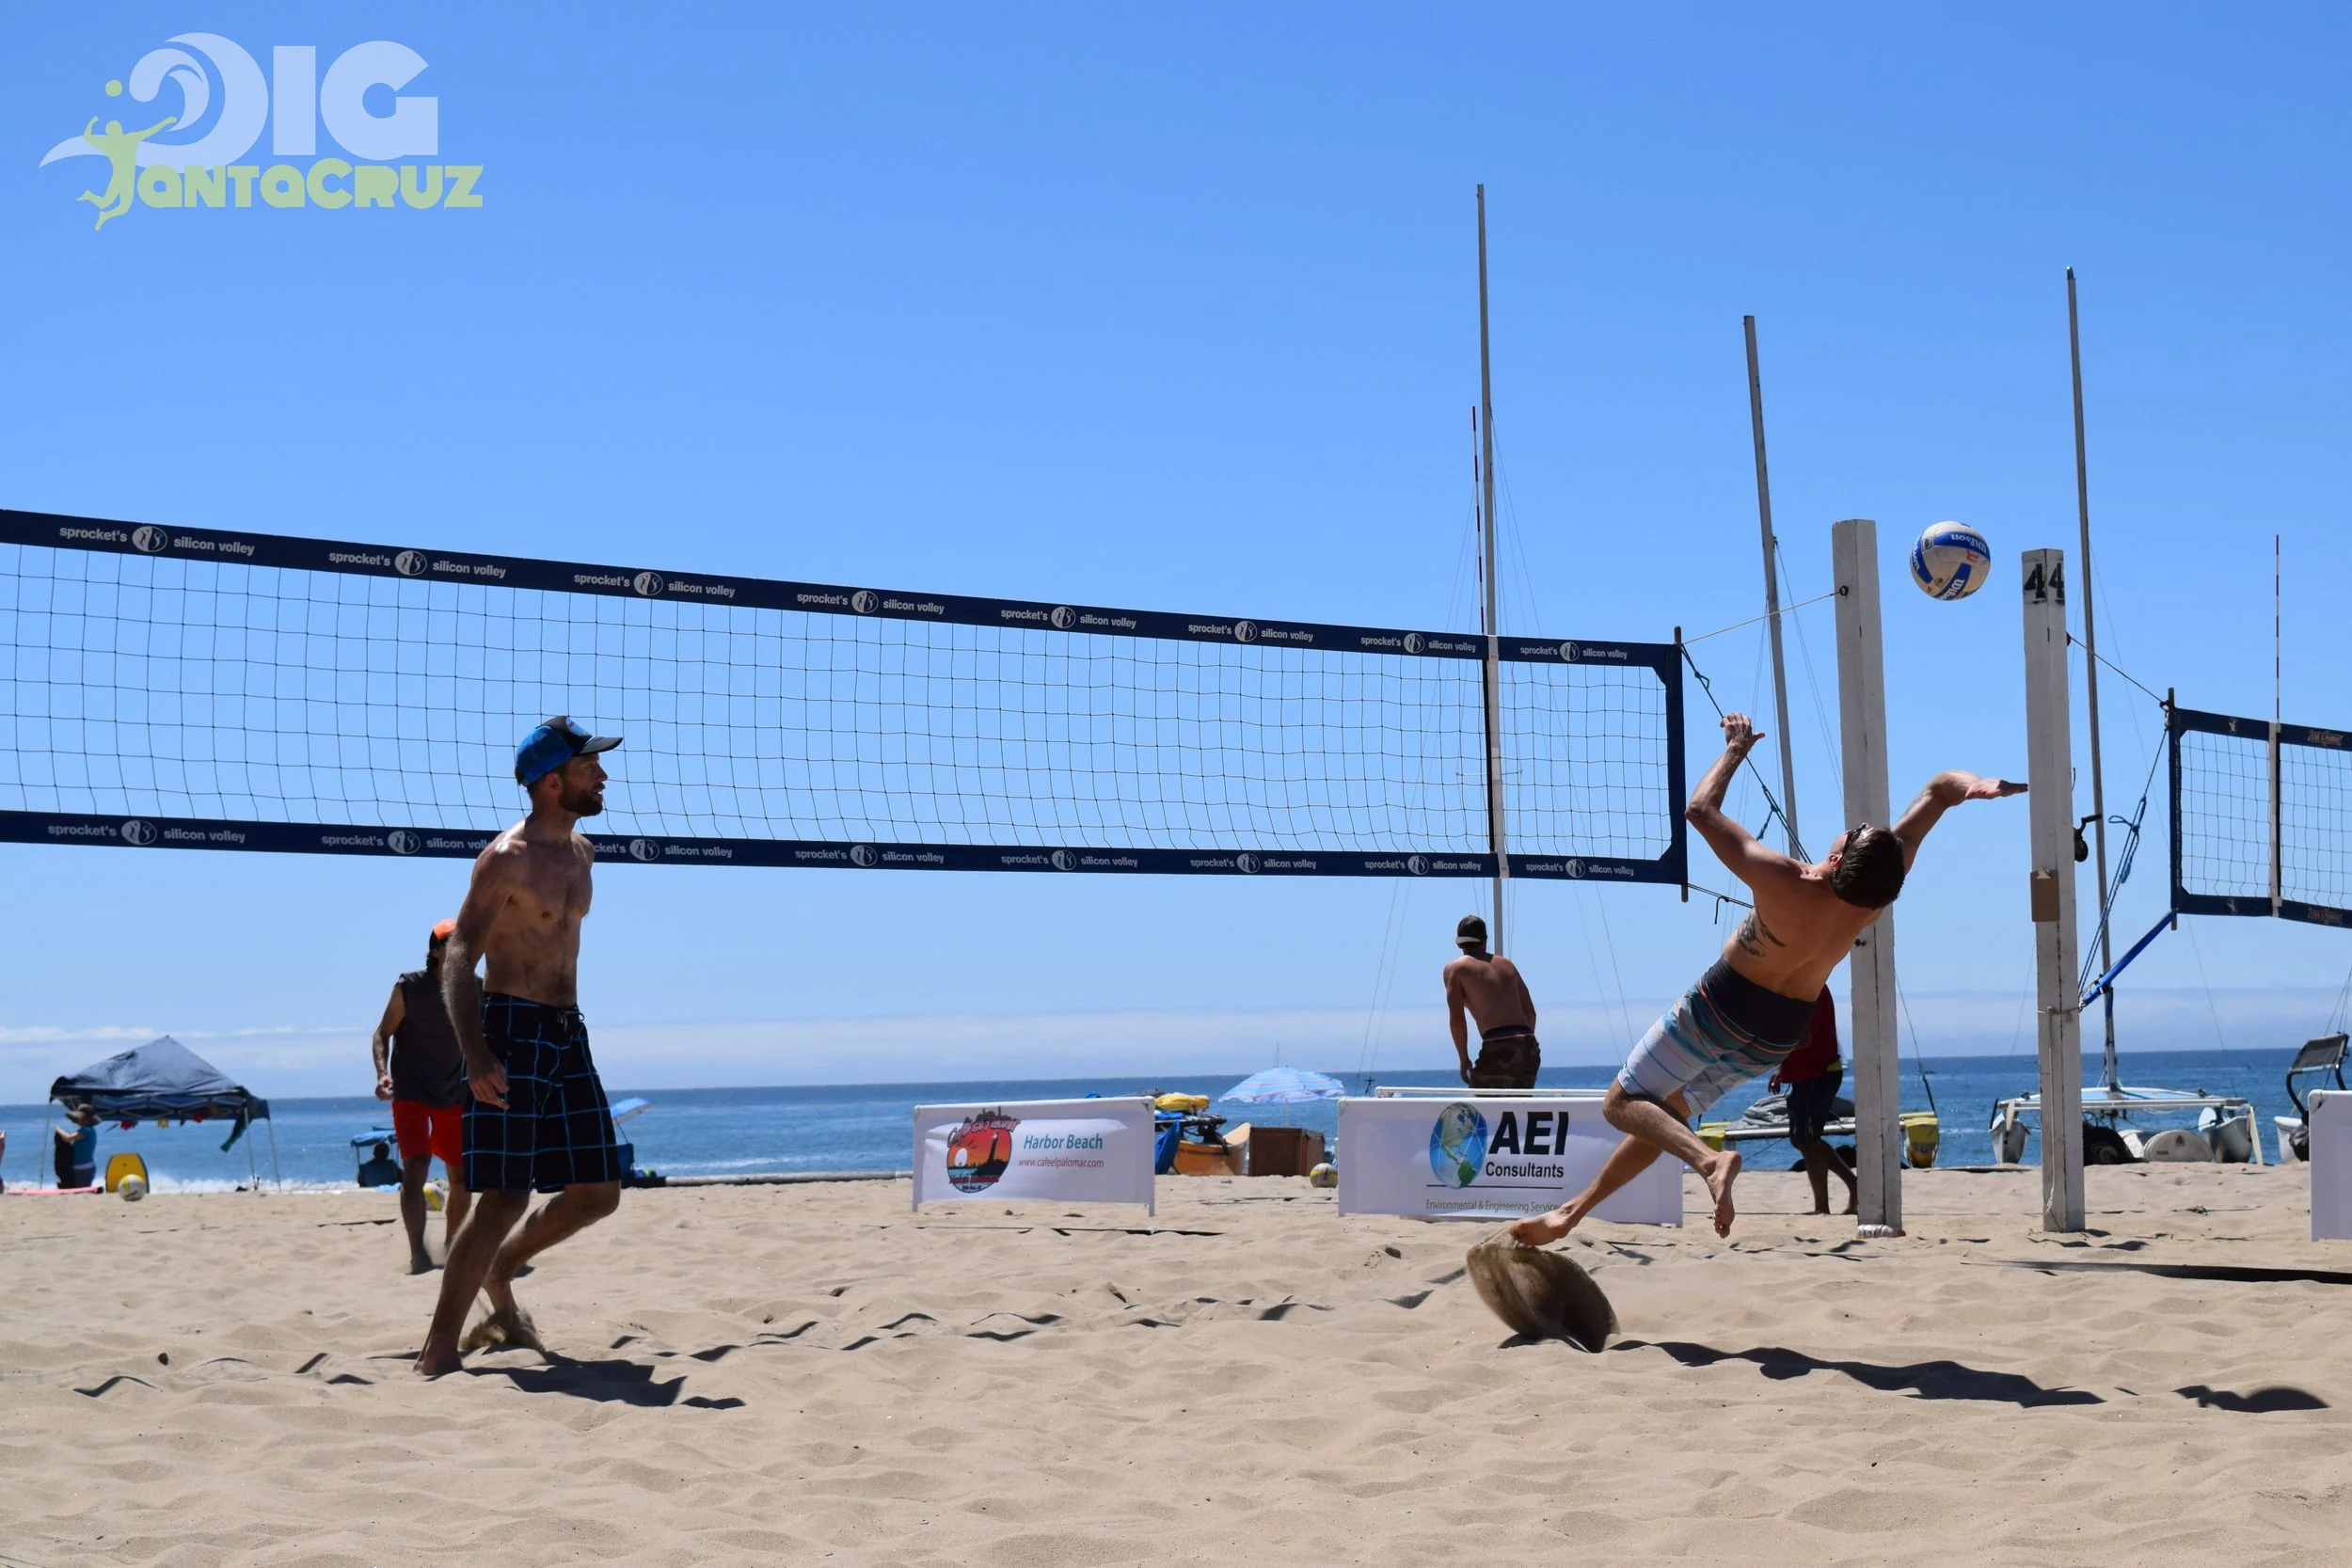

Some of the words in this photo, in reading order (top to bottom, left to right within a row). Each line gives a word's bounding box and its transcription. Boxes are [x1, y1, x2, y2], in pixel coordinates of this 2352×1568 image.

[59, 527, 128, 543] sprocket's
[173, 535, 215, 551] silicon
[218, 541, 256, 557] volley
[1950, 533, 1987, 554] Wilson
[328, 552, 391, 567] sprocket's
[432, 560, 470, 574] silicon
[473, 564, 507, 579] volley
[573, 574, 630, 588] sprocket's
[668, 580, 703, 594] silicon
[705, 584, 736, 599] volley
[797, 594, 849, 606] sprocket's
[882, 598, 914, 611] silicon
[916, 601, 946, 615] volley
[1000, 609, 1049, 622] sprocket's
[1079, 613, 1109, 626] silicon
[1110, 617, 1137, 630] volley
[1187, 624, 1232, 635] sprocket's
[1261, 627, 1288, 640] silicon
[1289, 630, 1314, 643] volley
[1428, 640, 1454, 650] silicon
[1454, 641, 1476, 654] volley
[1581, 647, 1606, 657] silicon
[1606, 649, 1628, 660] volley
[47, 824, 118, 837] sprocket's
[163, 828, 206, 841] silicon
[208, 830, 246, 844] volley
[321, 834, 385, 847] sprocket's
[425, 837, 465, 849] silicon
[467, 838, 489, 849] voll
[594, 842, 628, 854] cket's
[664, 845, 700, 856] silicon
[701, 846, 733, 859] volley
[794, 848, 848, 861] sprocket's
[882, 850, 914, 862] silicon
[915, 851, 945, 864] volley
[1000, 854, 1050, 865] sprocket's
[1080, 855, 1111, 866] silicon
[1111, 856, 1138, 868] volley
[1189, 857, 1235, 869] sprocket's
[1263, 858, 1292, 868] silicon
[1292, 859, 1317, 870] volley
[1432, 860, 1458, 870] silicon
[1458, 861, 1482, 872] volley
[1588, 863, 1613, 874] silicon
[1613, 865, 1634, 878] volley
[1024, 1132, 1064, 1149] Harbor
[1066, 1132, 1104, 1149] Beach
[1488, 1111, 1568, 1156] AEI
[1018, 1156, 1104, 1169] www.cafeelpalomar.com
[1486, 1161, 1565, 1179] Consultants
[1425, 1198, 1477, 1211] Environmental
[1478, 1200, 1485, 1210] &
[1485, 1200, 1529, 1213] Engineering
